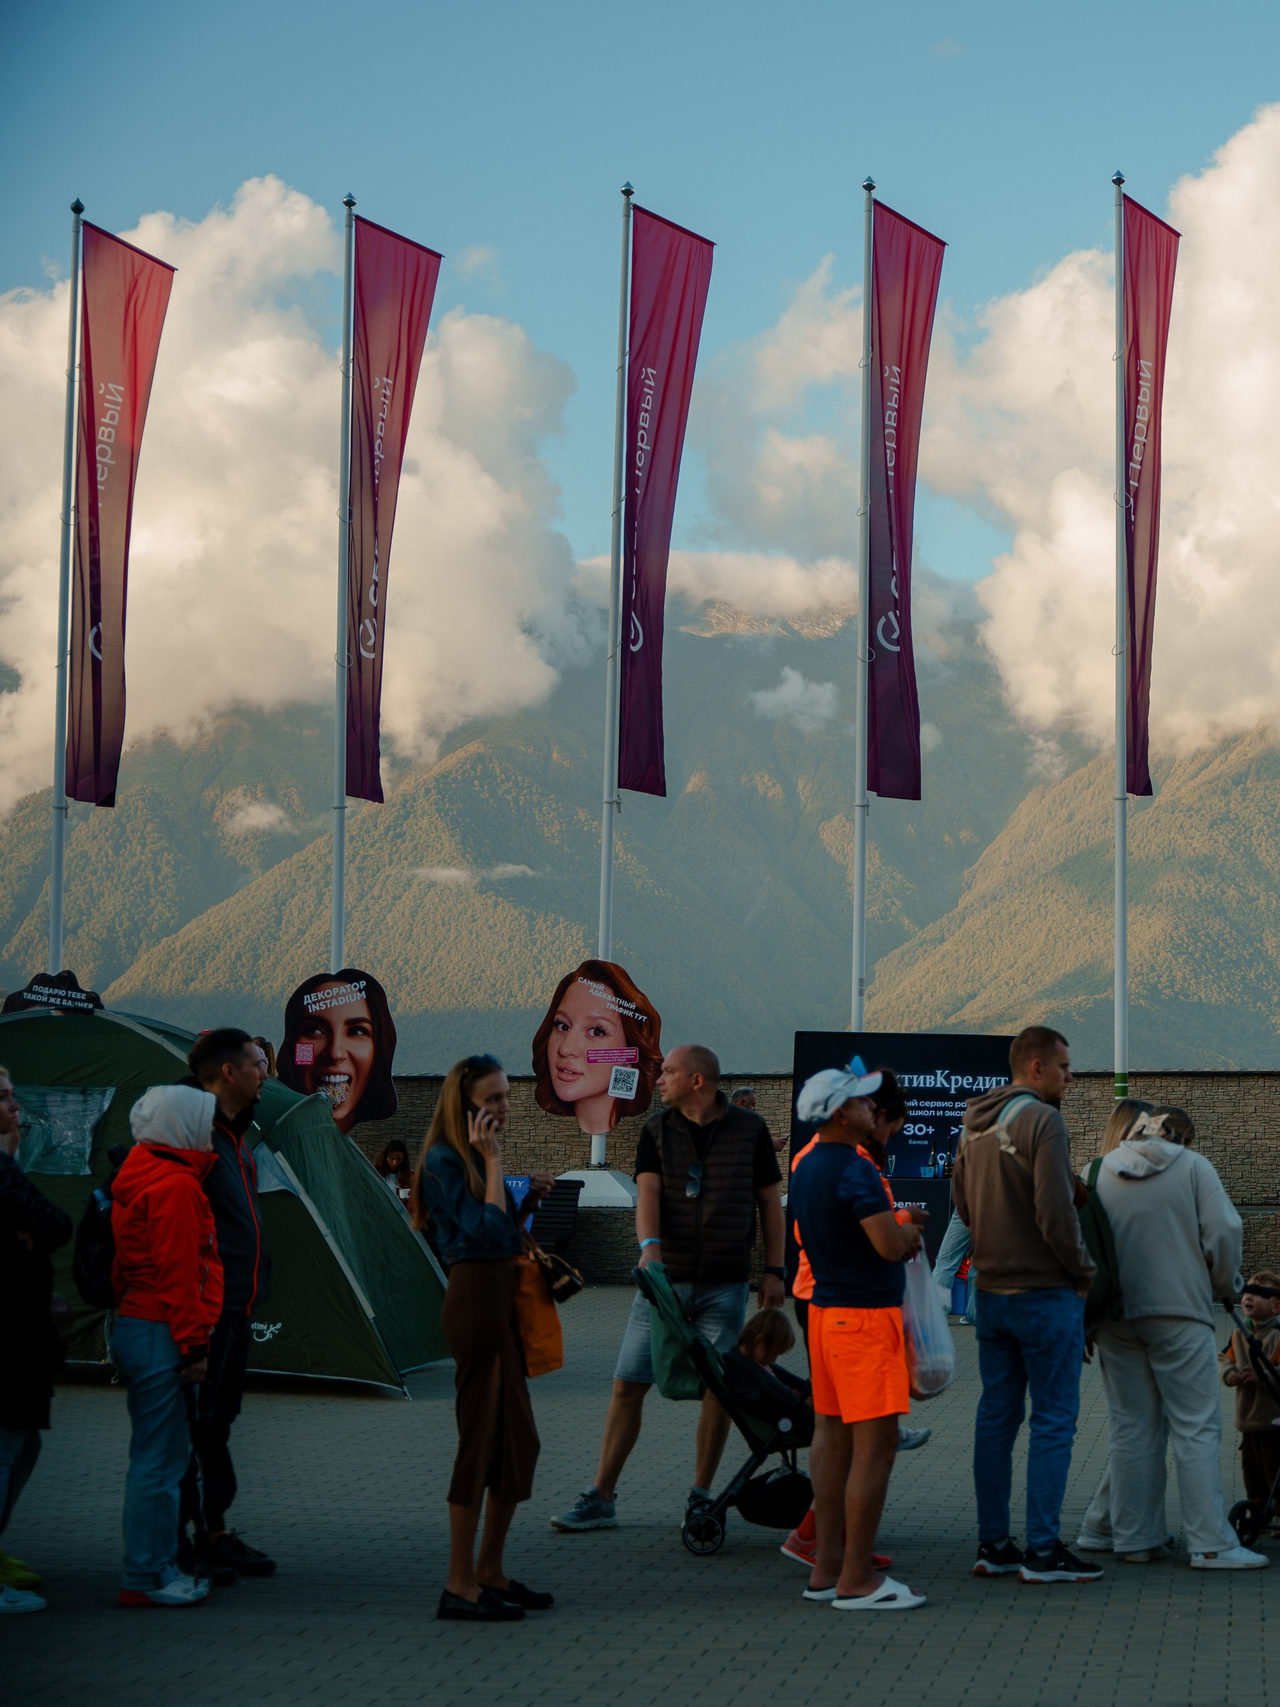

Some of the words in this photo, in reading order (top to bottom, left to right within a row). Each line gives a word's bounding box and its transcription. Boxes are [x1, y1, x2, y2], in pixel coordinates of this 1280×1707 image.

[577, 976, 605, 990] САМЫЙ
[23, 992, 48, 1002] ТАКОЙ
[33, 985, 67, 997] ПОДАРЮ
[67, 991, 87, 999] ТЕБЕ
[303, 980, 367, 1006] ДЕКОРАТОР
[588, 988, 637, 1010] АДЕКВАТНЫЙ
[307, 991, 367, 1013] INSTADIUM
[606, 1002, 634, 1017] ТРАФИК
[634, 1014, 648, 1022] ТУТ
[895, 1069, 1009, 1094] ктивКредит
[919, 1100, 954, 1108] сервис
[903, 1123, 935, 1136] 30+
[506, 1180, 525, 1188] ITY
